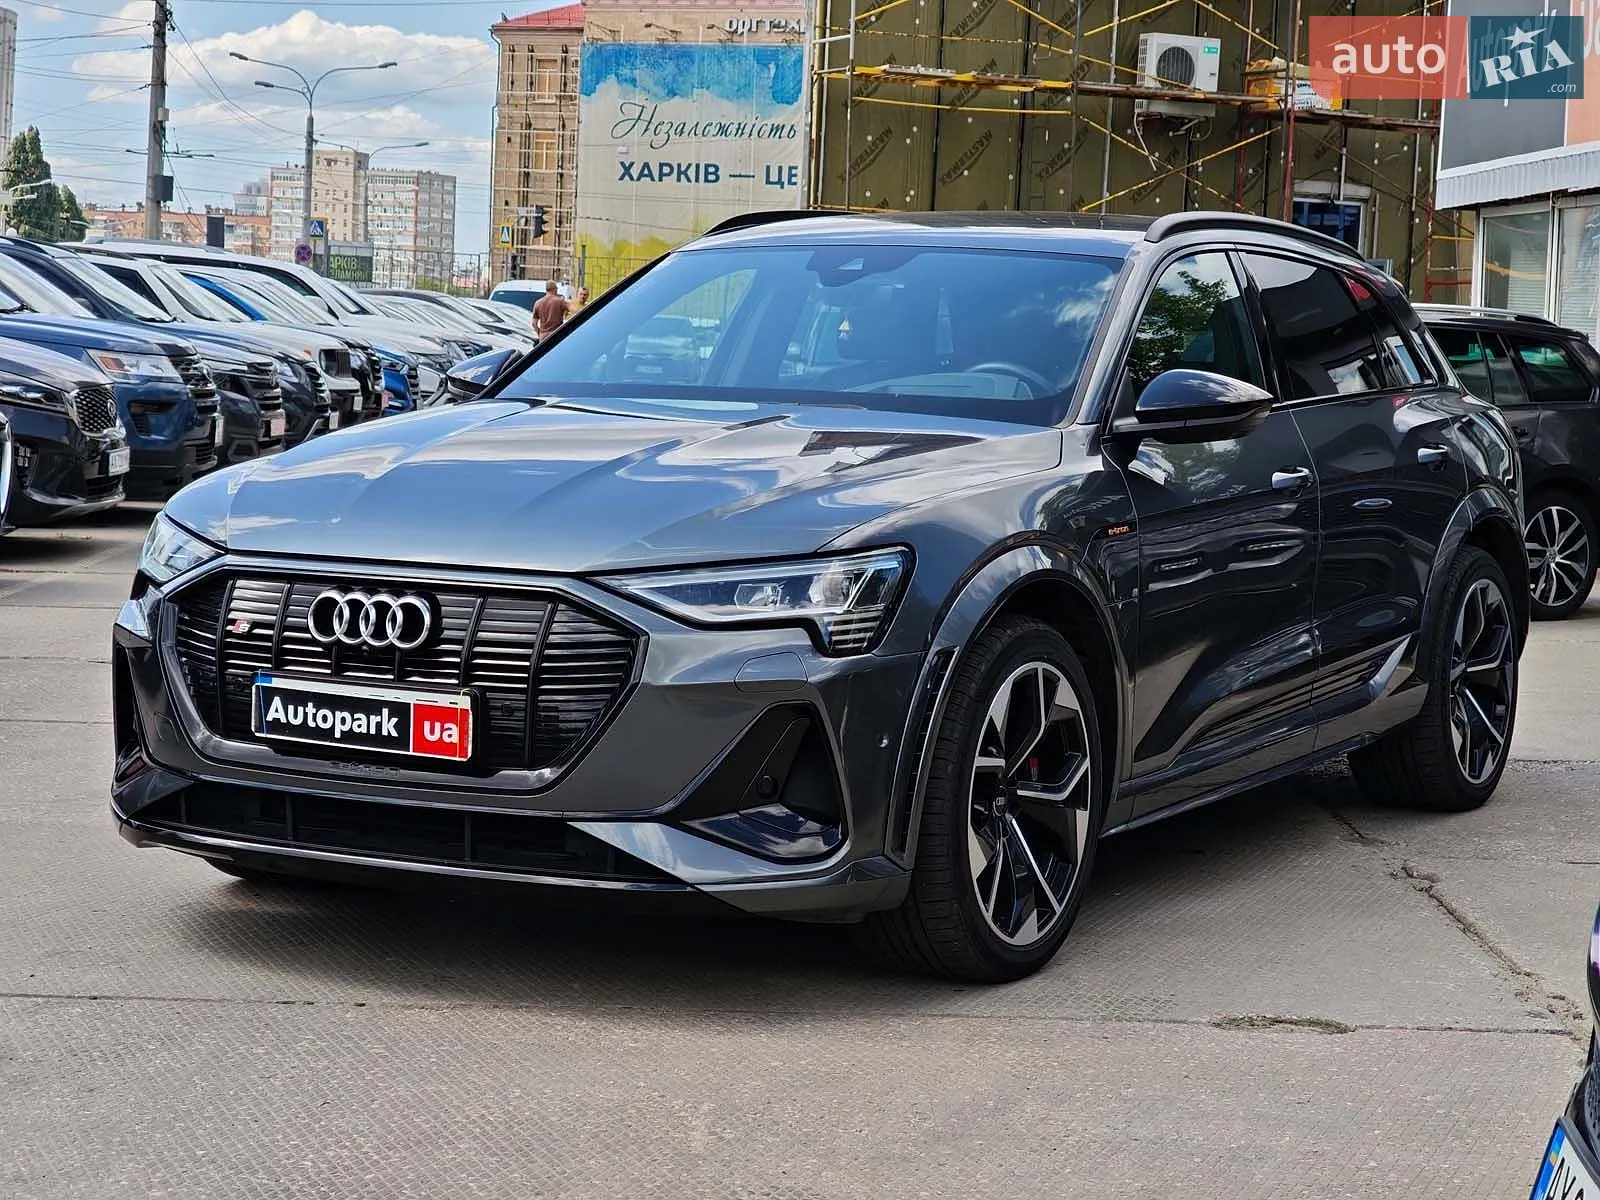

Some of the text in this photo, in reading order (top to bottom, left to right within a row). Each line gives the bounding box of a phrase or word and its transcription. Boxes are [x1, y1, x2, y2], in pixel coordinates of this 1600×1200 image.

[610, 101, 798, 150] Незалежність
[618, 161, 720, 184] ХАРКІВ
[765, 164, 799, 189] ЦЕ
[329, 255, 358, 270] АРКІВ
[265, 696, 399, 739] Autopark
[423, 719, 459, 744] ua
